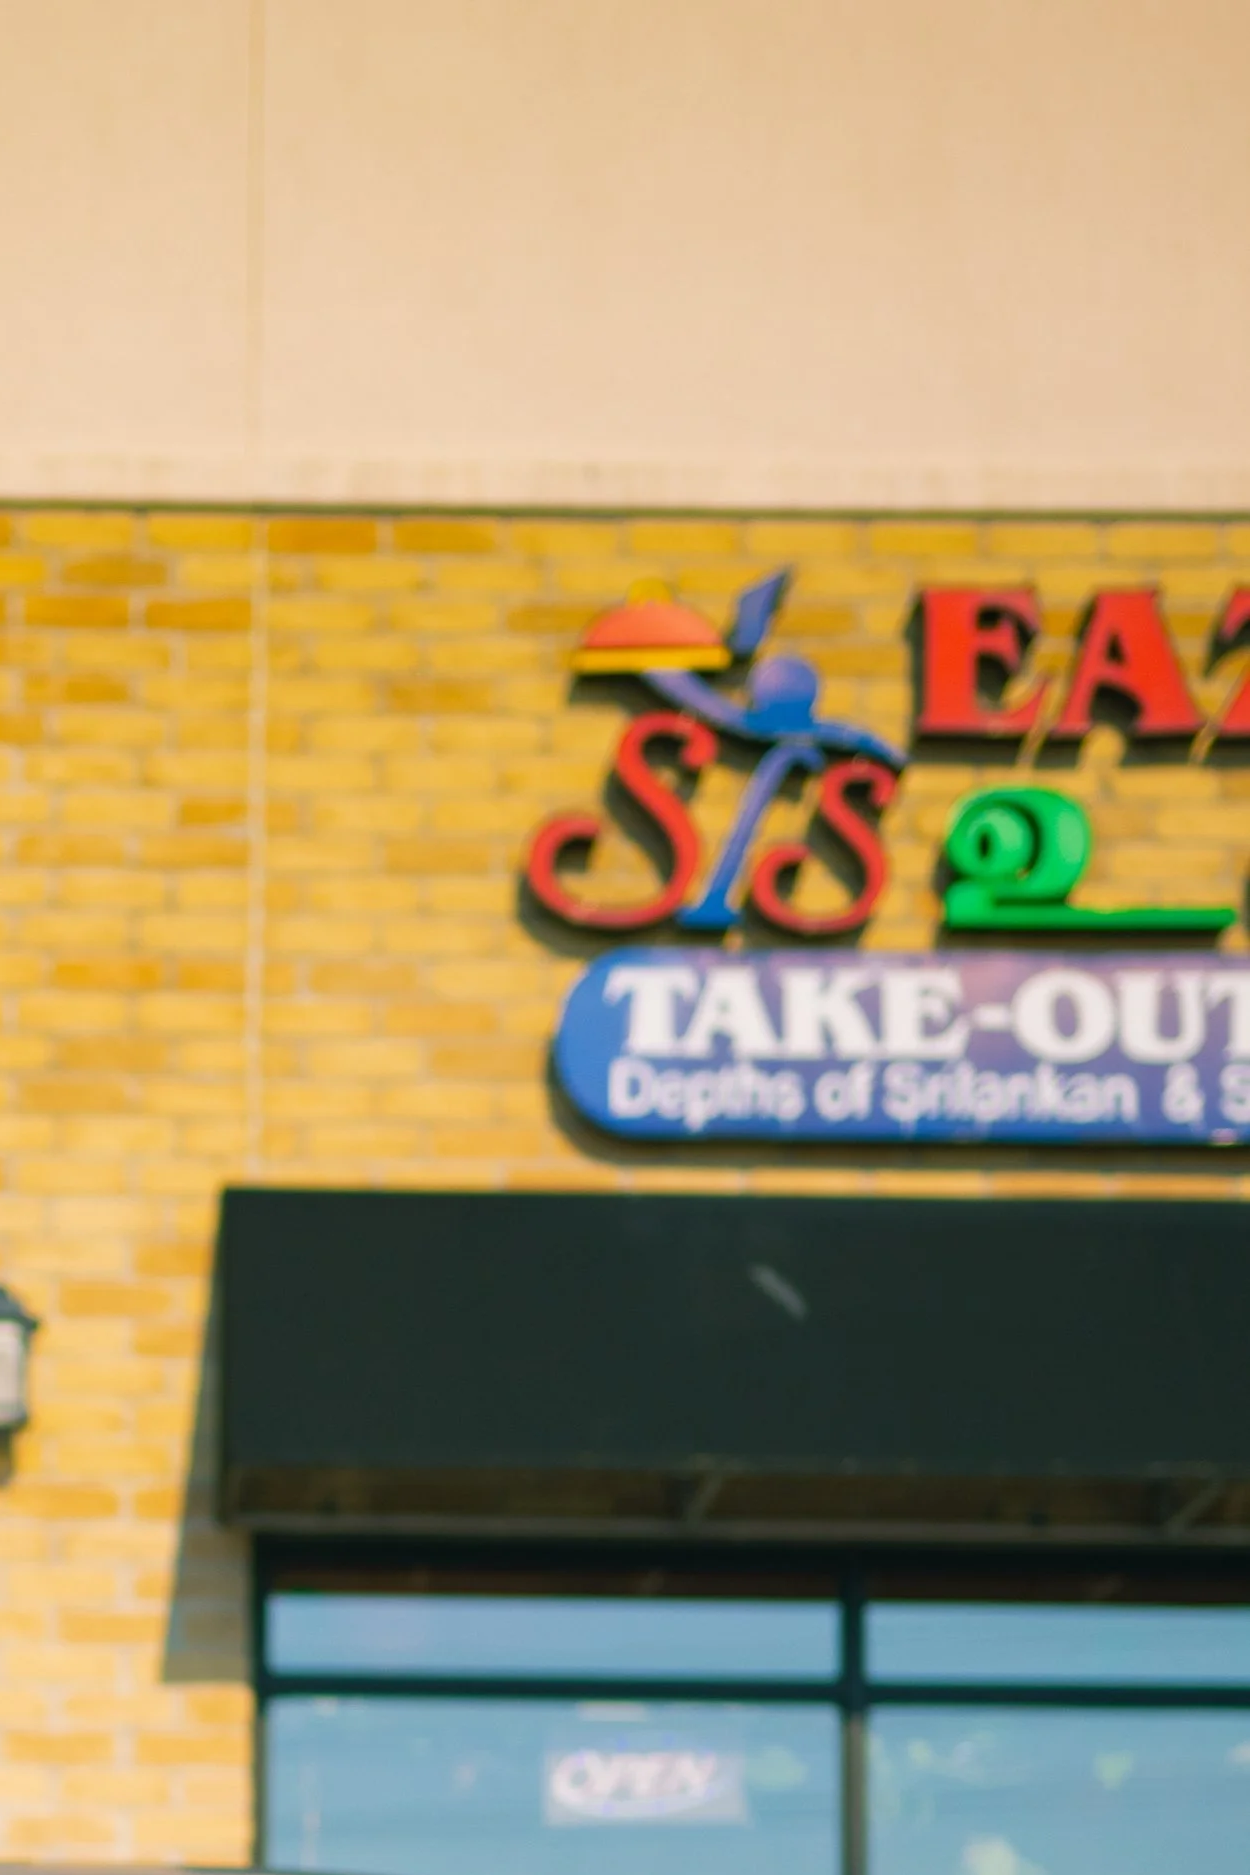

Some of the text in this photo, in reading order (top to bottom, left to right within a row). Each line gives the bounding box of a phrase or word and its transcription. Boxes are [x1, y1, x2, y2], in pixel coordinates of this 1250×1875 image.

[608, 1056, 807, 1133] Depths
[814, 1059, 873, 1122] of
[1162, 1062, 1205, 1124] &
